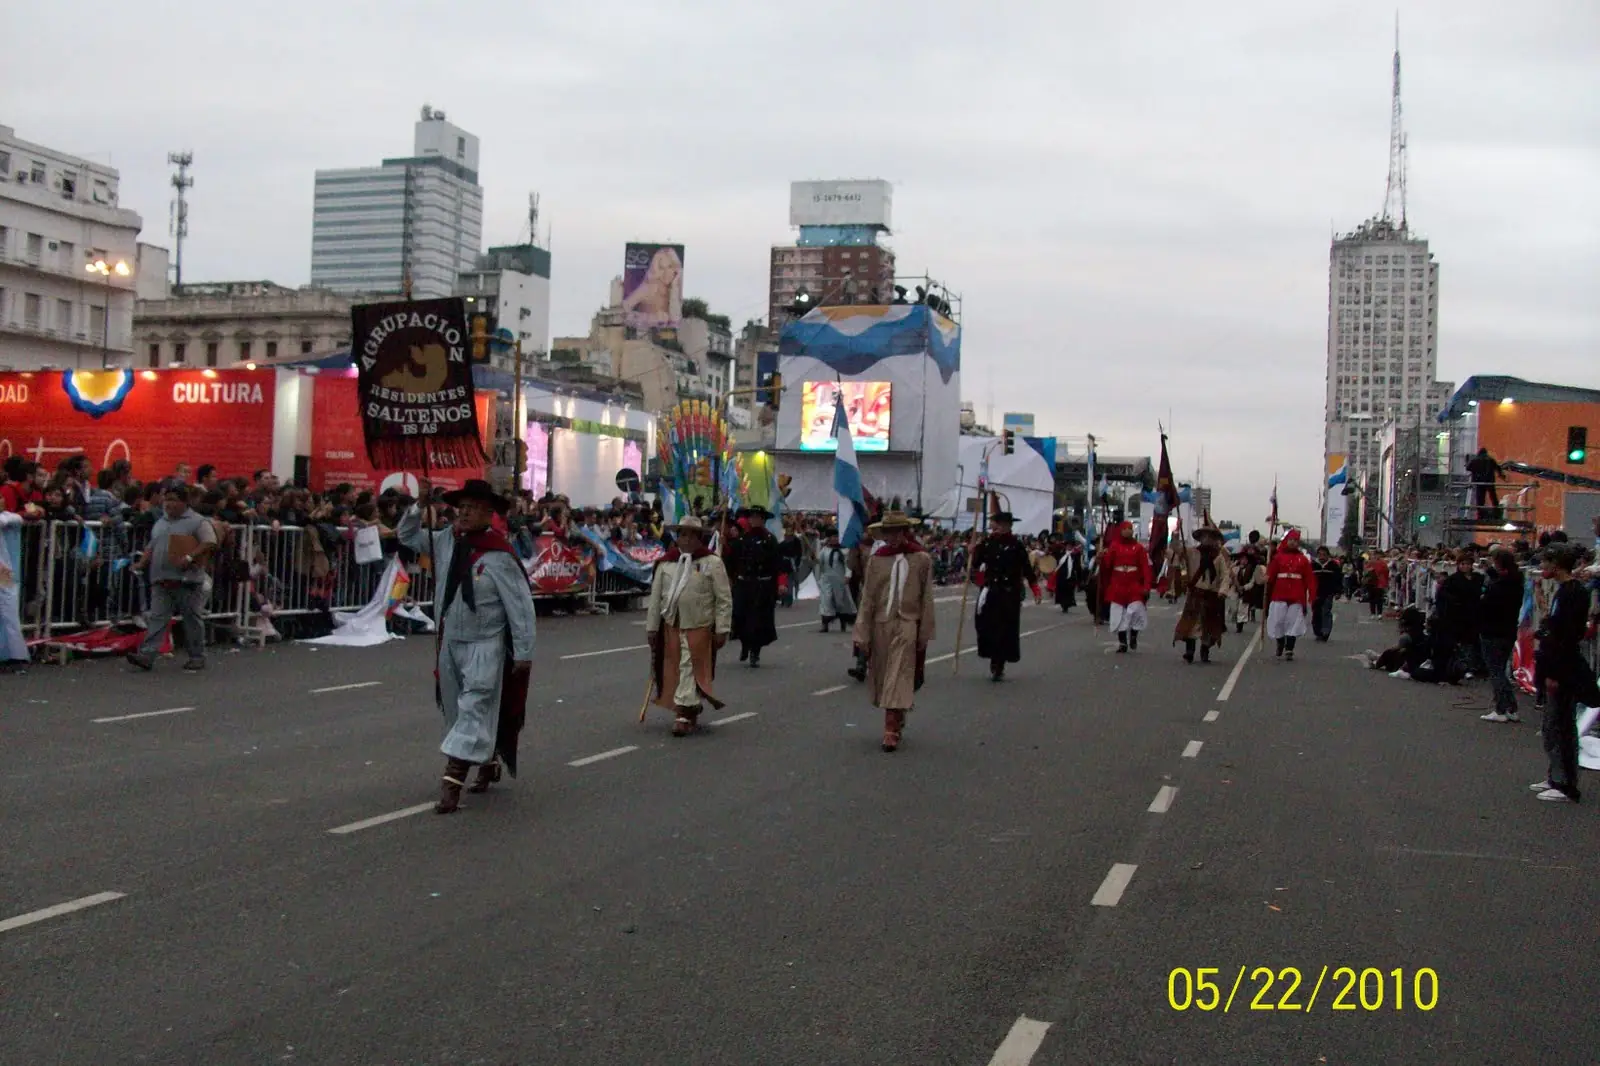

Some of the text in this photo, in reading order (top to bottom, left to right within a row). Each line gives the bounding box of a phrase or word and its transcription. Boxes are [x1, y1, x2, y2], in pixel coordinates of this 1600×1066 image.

[361, 311, 464, 372] AGRUPACION
[173, 383, 263, 404] CULTURA
[370, 383, 466, 404] RESIDENTES
[367, 402, 472, 424] SALTEÑOS
[422, 422, 438, 434] AS
